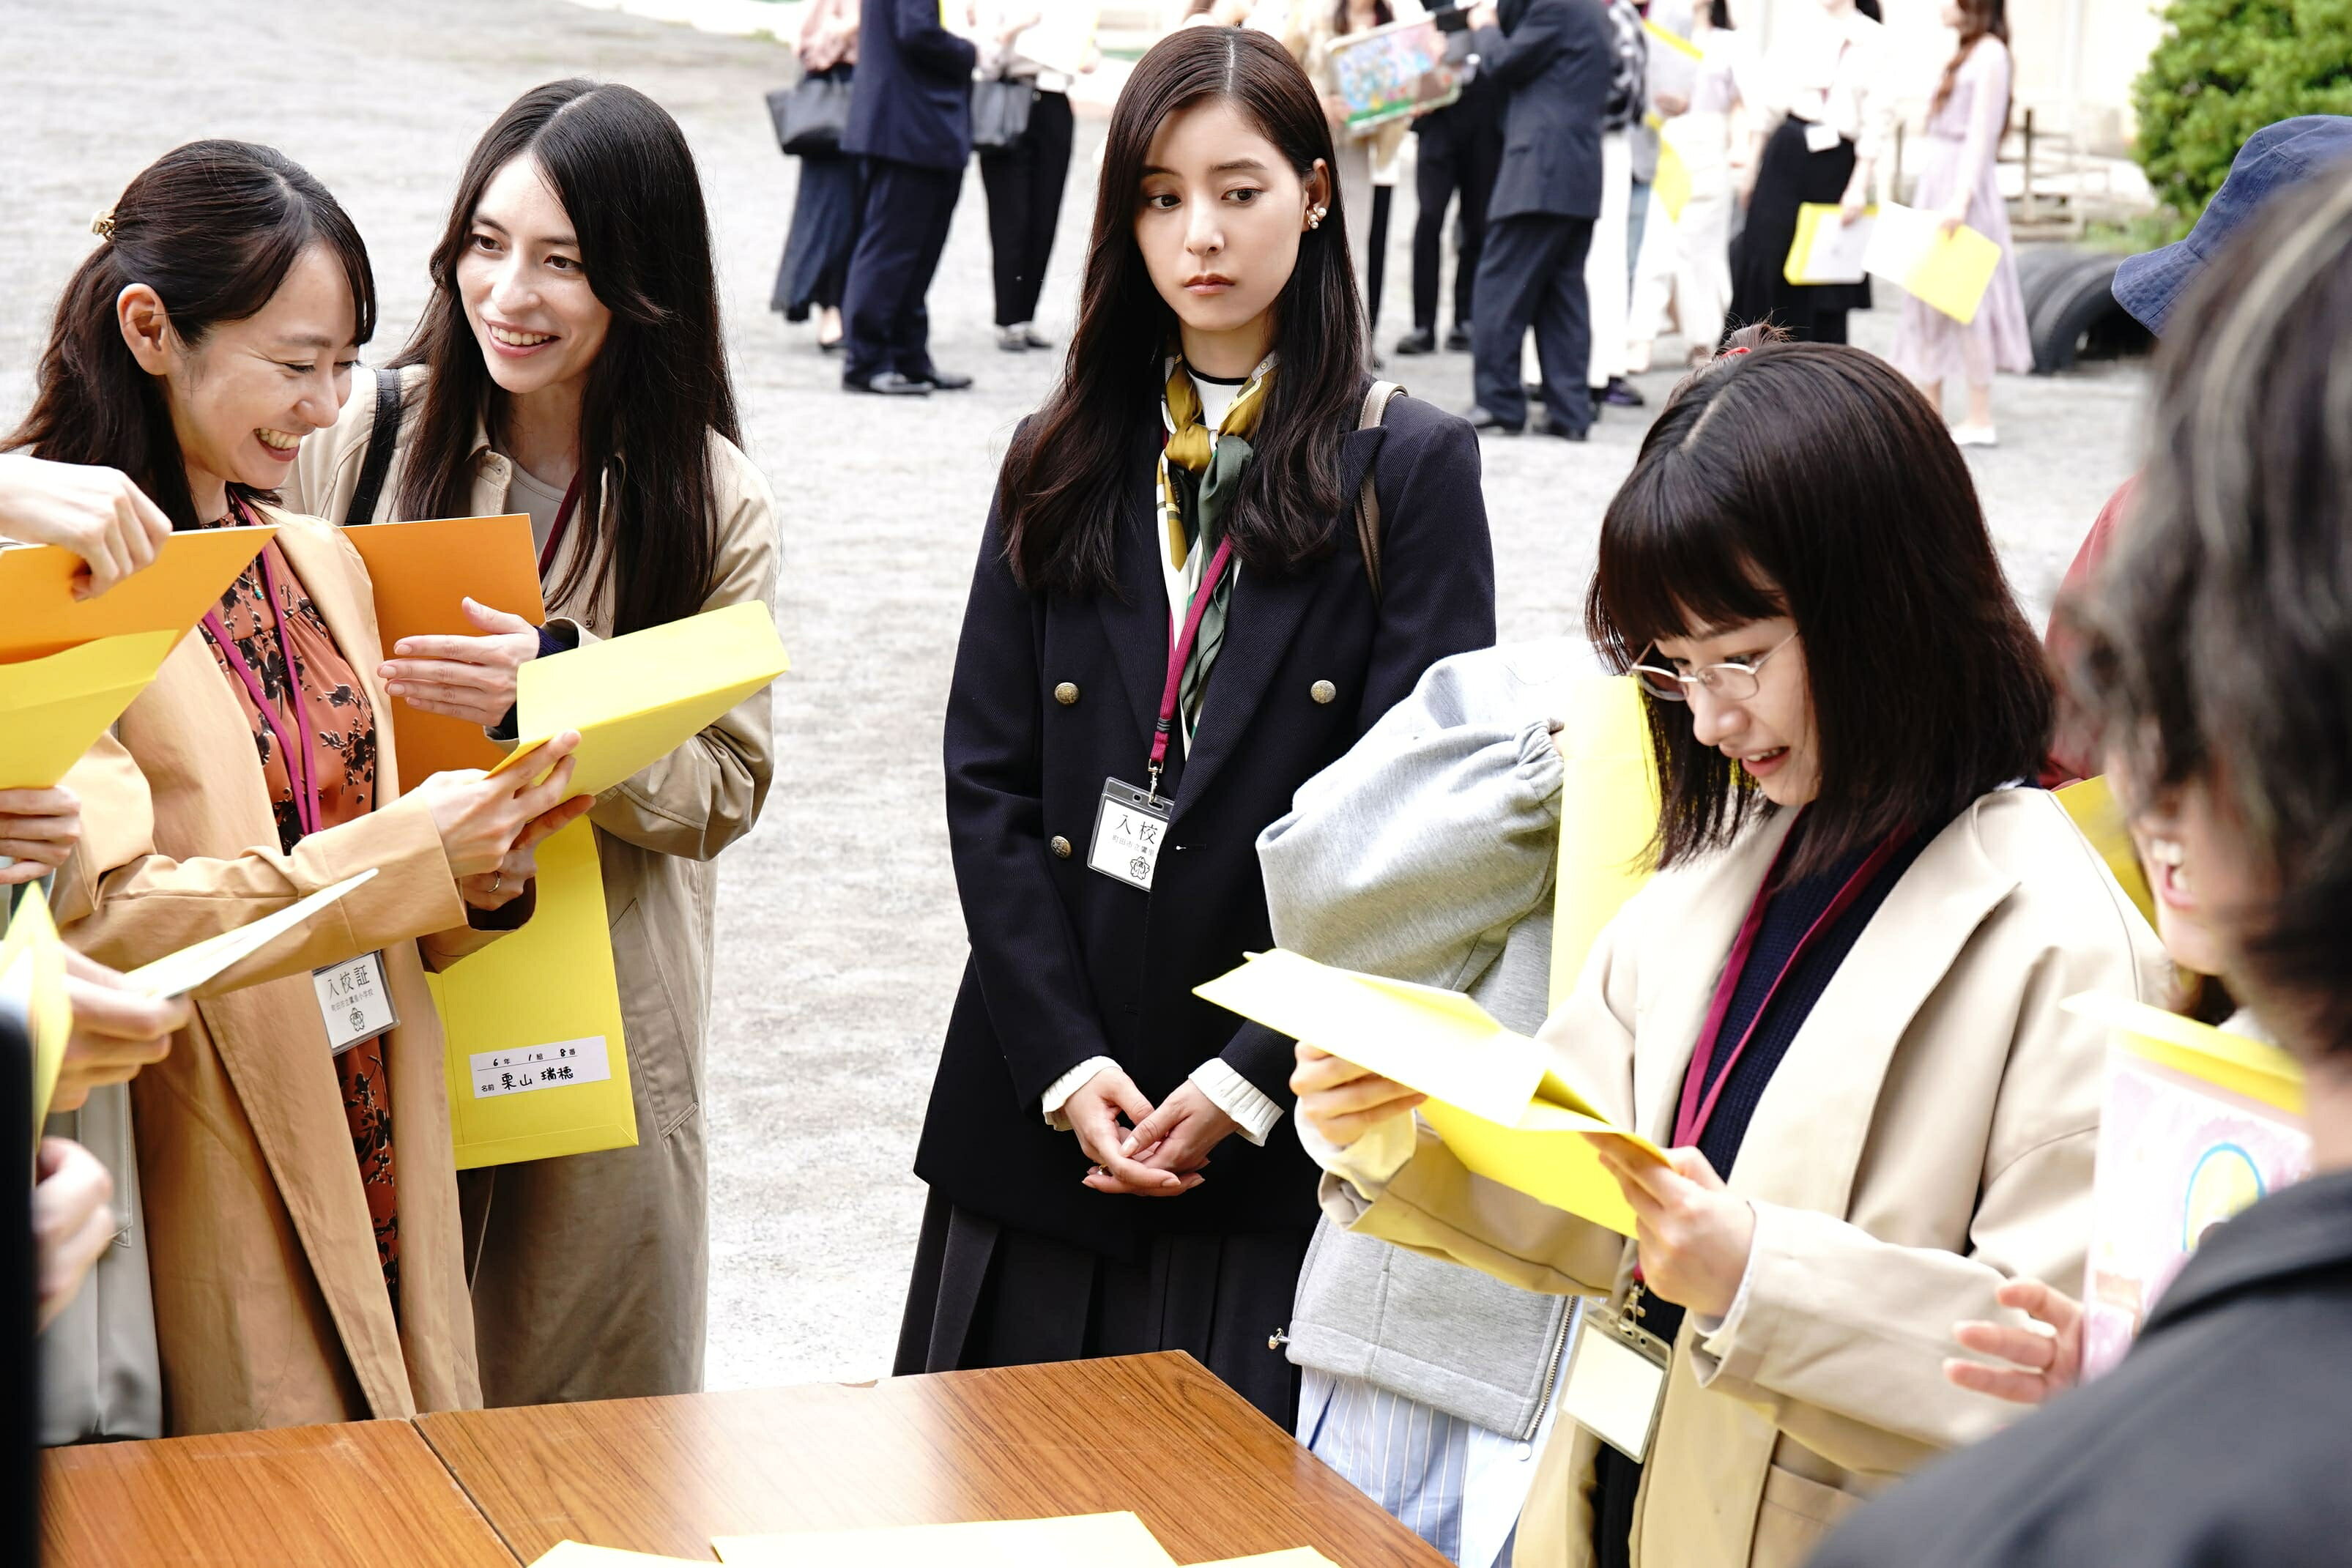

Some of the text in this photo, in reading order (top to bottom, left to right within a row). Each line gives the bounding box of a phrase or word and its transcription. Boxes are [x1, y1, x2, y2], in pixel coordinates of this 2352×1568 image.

[1115, 814, 1157, 844] 入校
[327, 965, 370, 1000] 入校証
[481, 1084, 494, 1092] 名前
